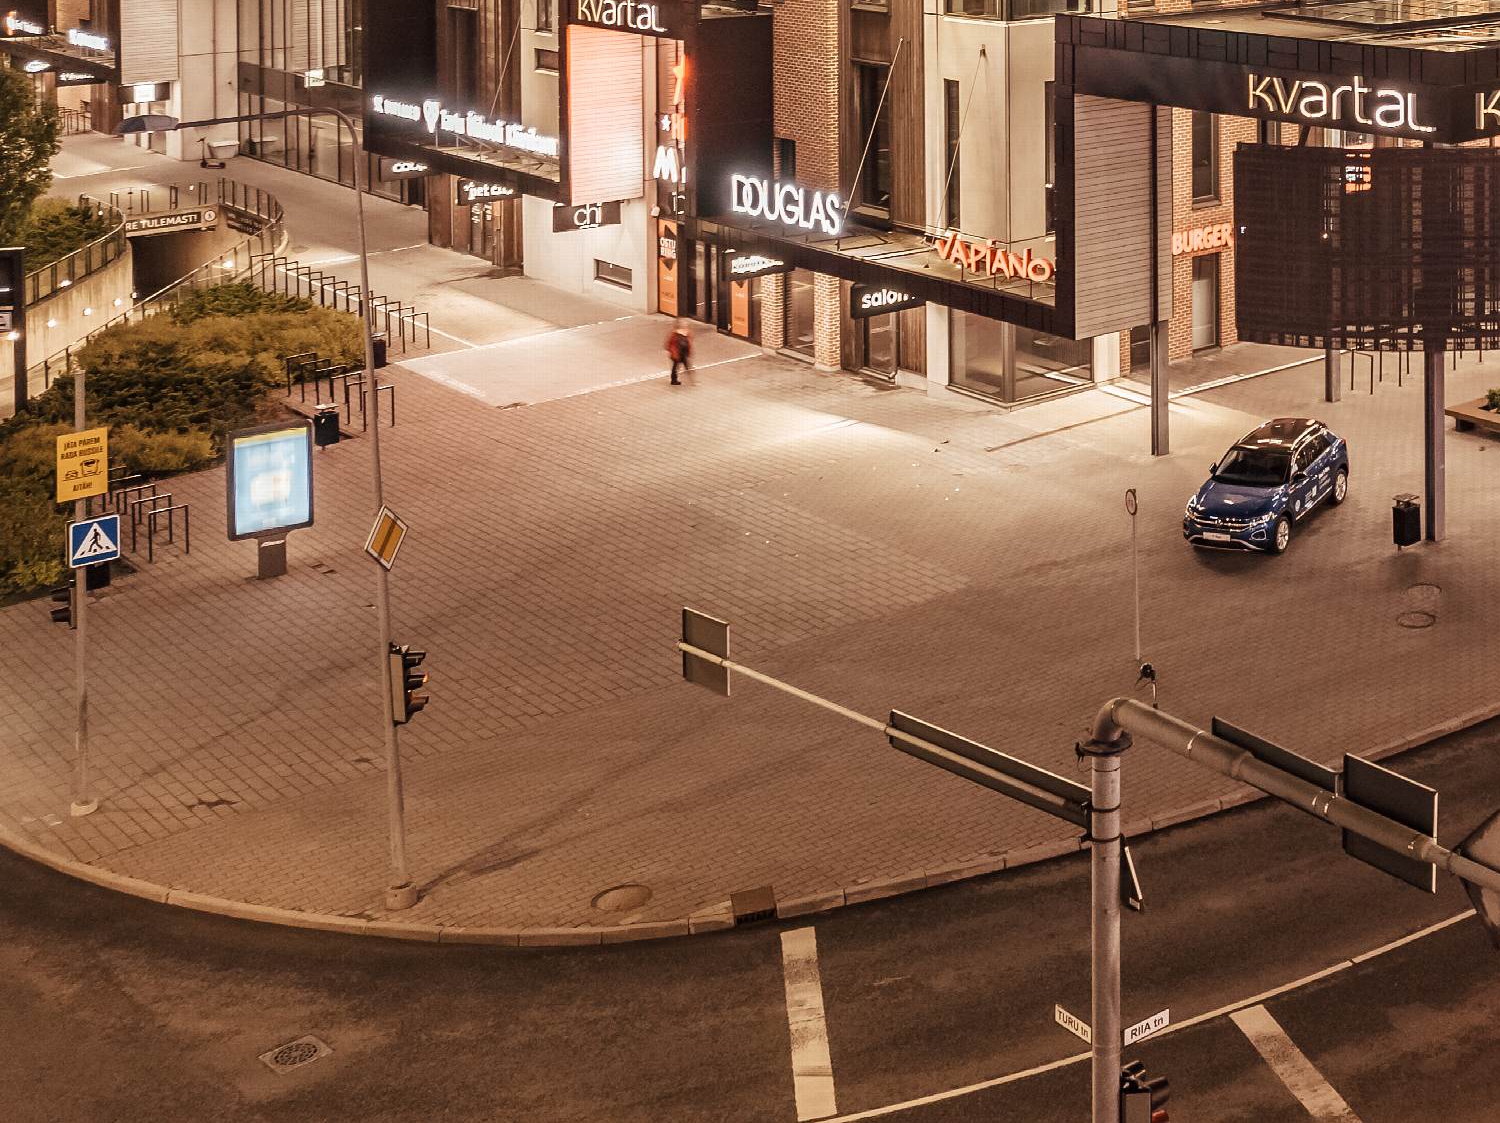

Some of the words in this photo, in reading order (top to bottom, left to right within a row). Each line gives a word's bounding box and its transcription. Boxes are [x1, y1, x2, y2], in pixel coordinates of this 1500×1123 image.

[731, 174, 841, 236] DOUGLAS
[140, 214, 198, 229] TULEMAST!
[1171, 222, 1234, 256] BURGER
[936, 231, 1053, 283] VAPIANO
[1057, 1009, 1079, 1032] TURU
[1081, 1026, 1089, 1037] tn
[1130, 1022, 1151, 1039] RIIA
[1154, 1017, 1164, 1028] tn
